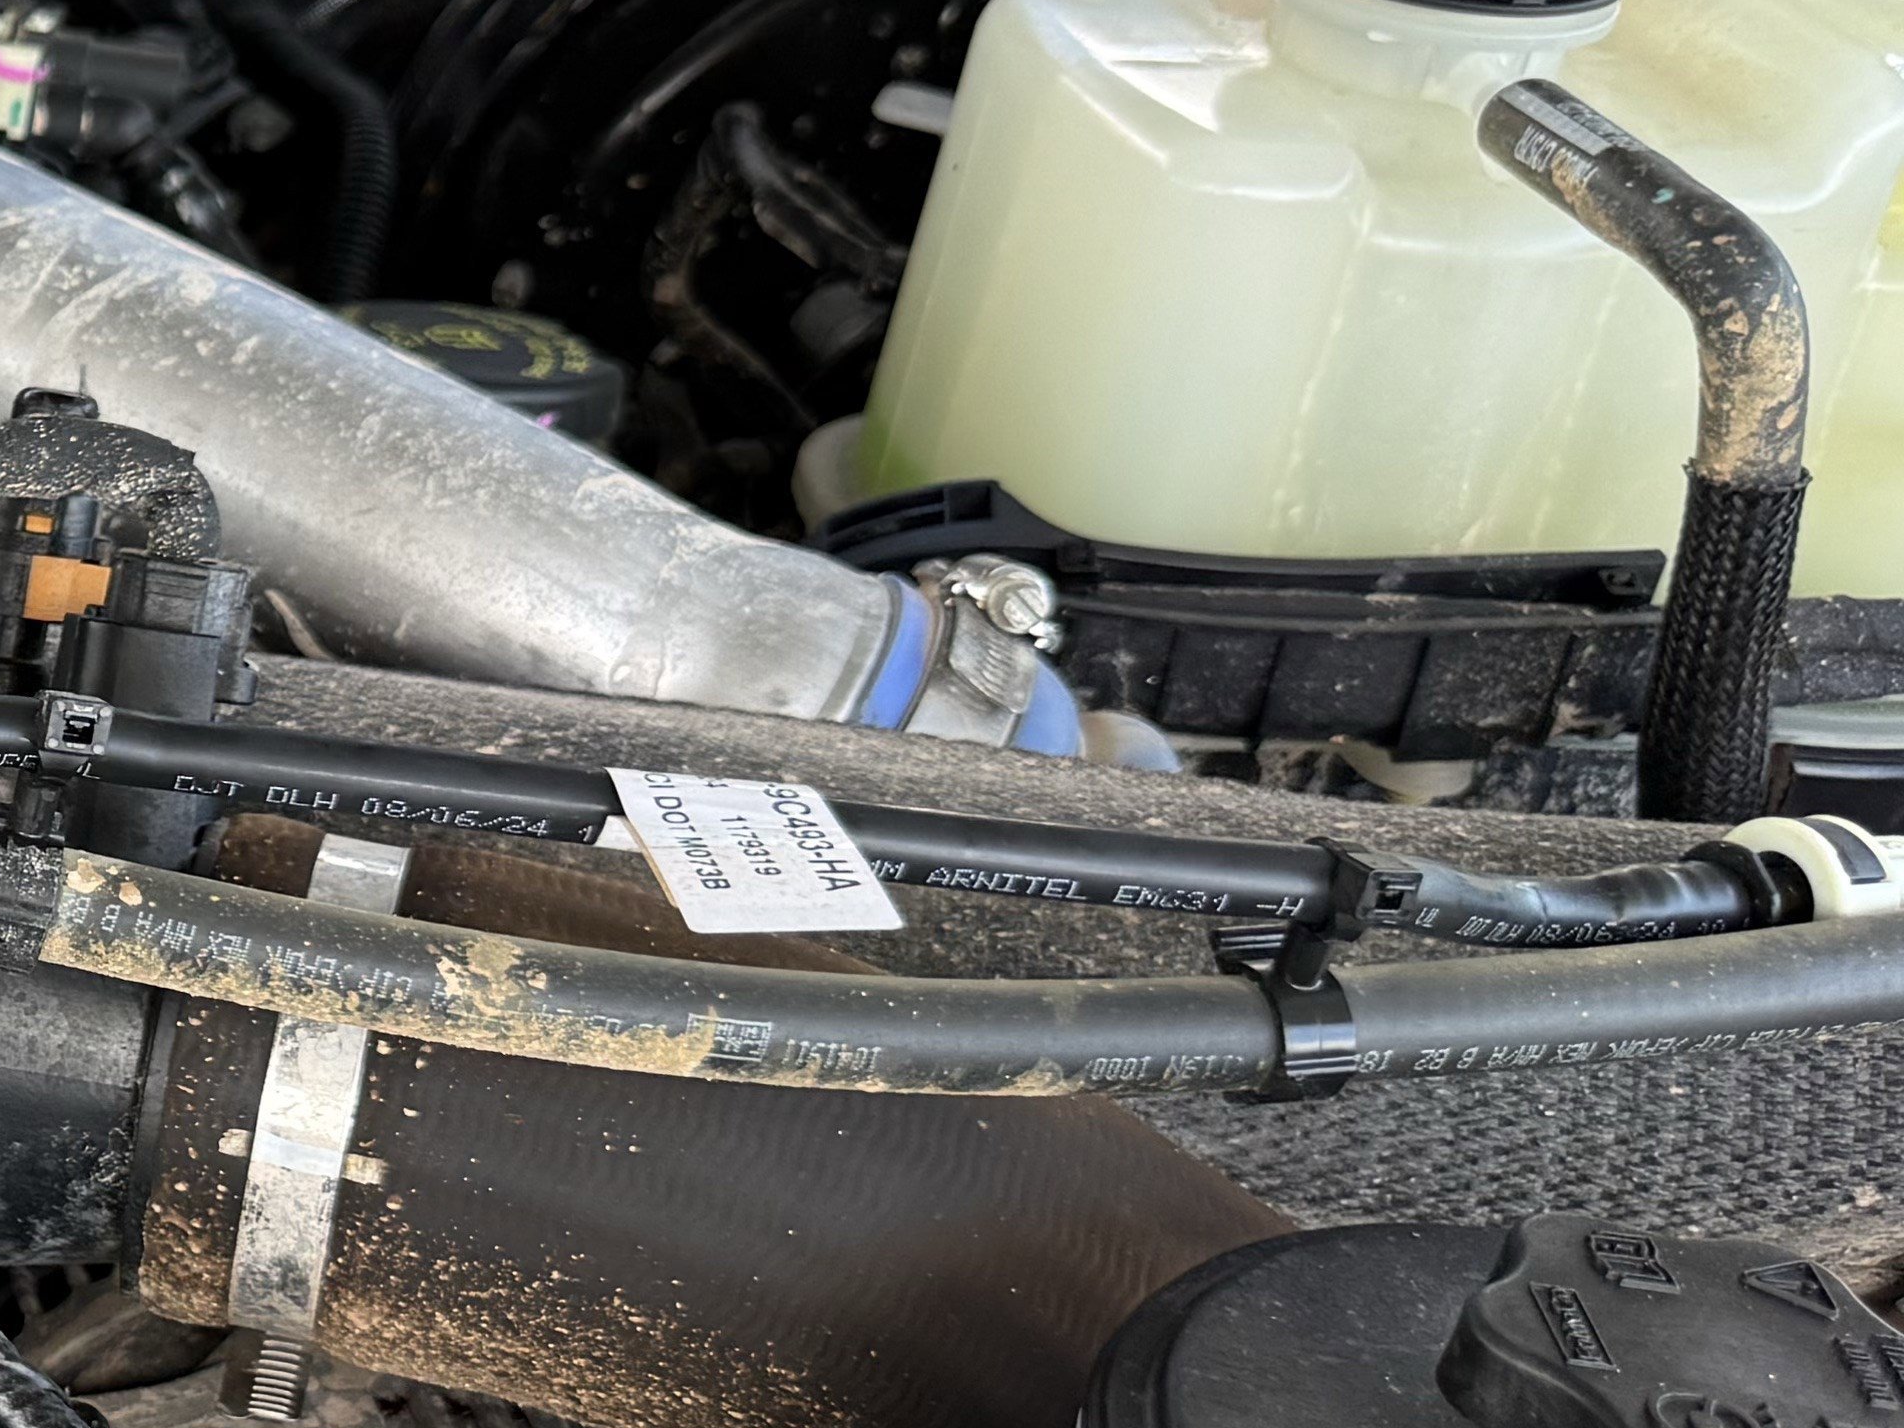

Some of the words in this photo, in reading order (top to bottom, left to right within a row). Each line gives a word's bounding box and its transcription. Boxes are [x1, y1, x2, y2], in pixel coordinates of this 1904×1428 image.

[361, 796, 549, 837] 08/06/24
[653, 795, 696, 832] DOT
[675, 836, 731, 890] M073B
[720, 815, 782, 876] 1179319
[925, 866, 1088, 901] ARNITEL
